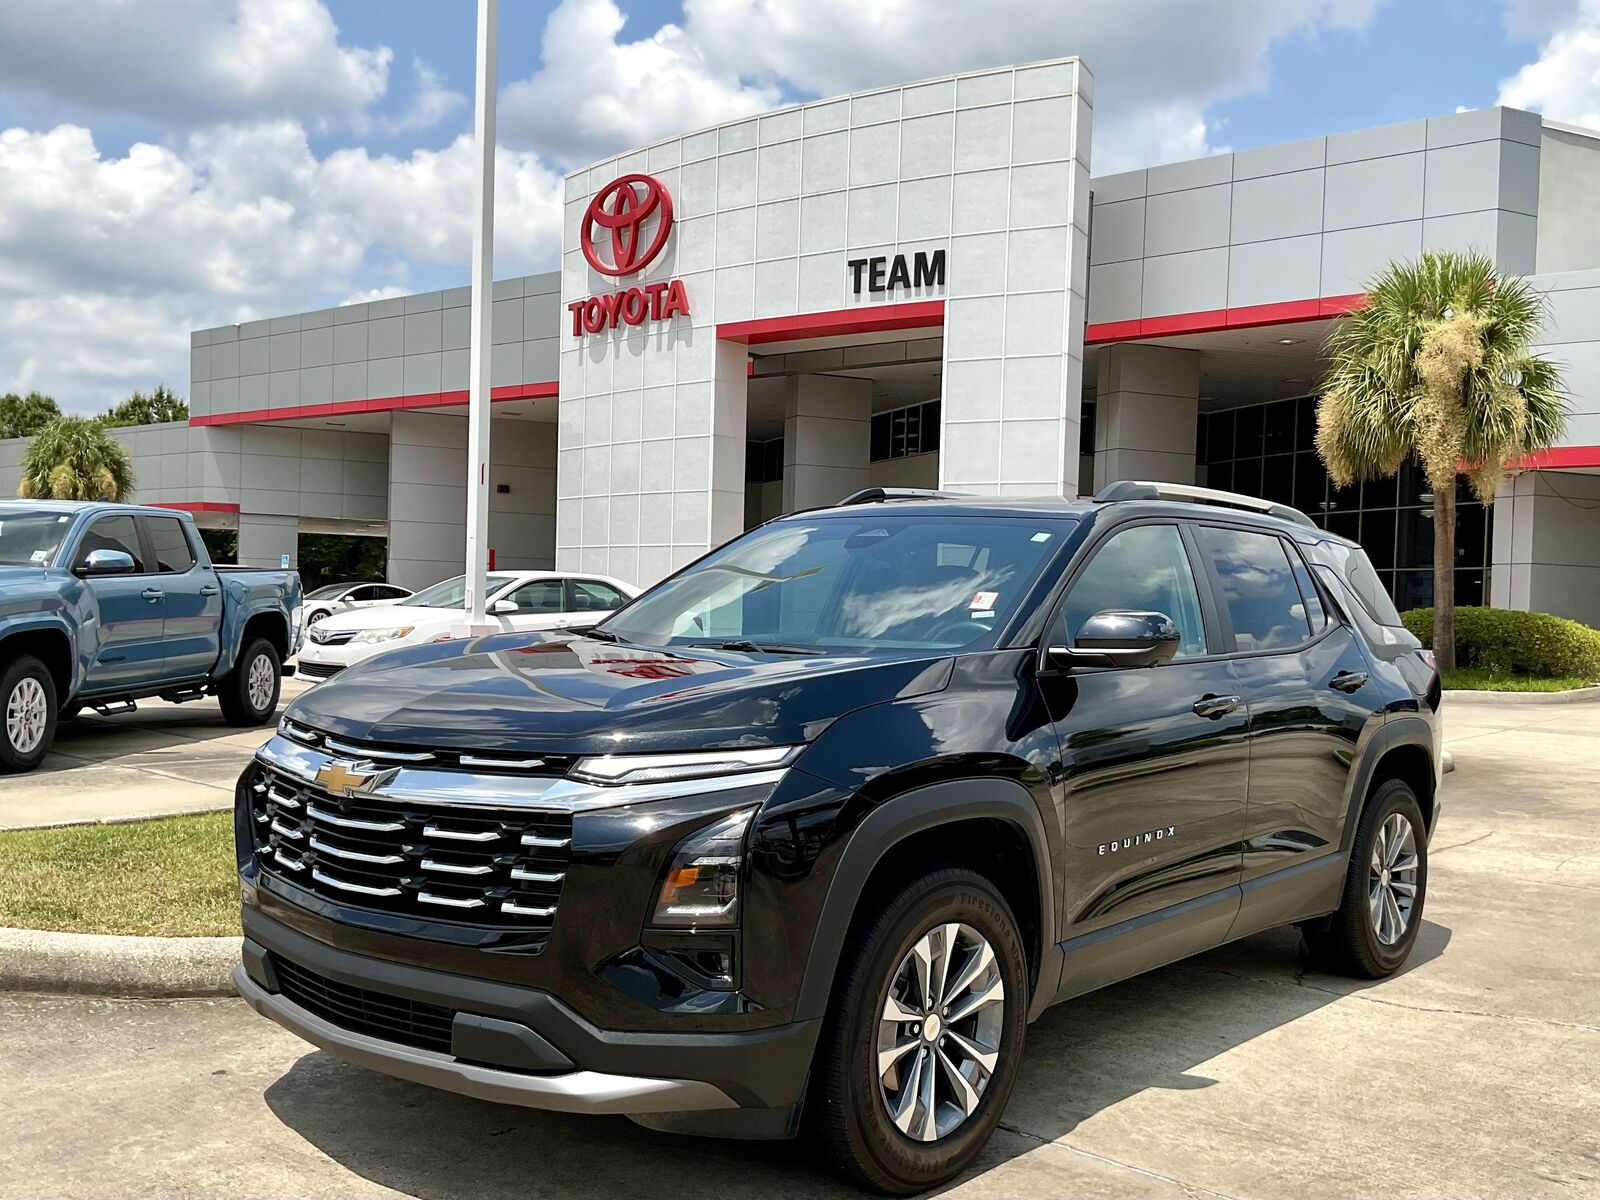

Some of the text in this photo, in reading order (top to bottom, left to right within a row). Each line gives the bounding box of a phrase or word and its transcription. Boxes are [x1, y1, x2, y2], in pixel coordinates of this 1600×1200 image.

[847, 249, 946, 294] TEAM
[568, 280, 691, 337] TOYOTA
[1098, 826, 1175, 856] EQUINOX
